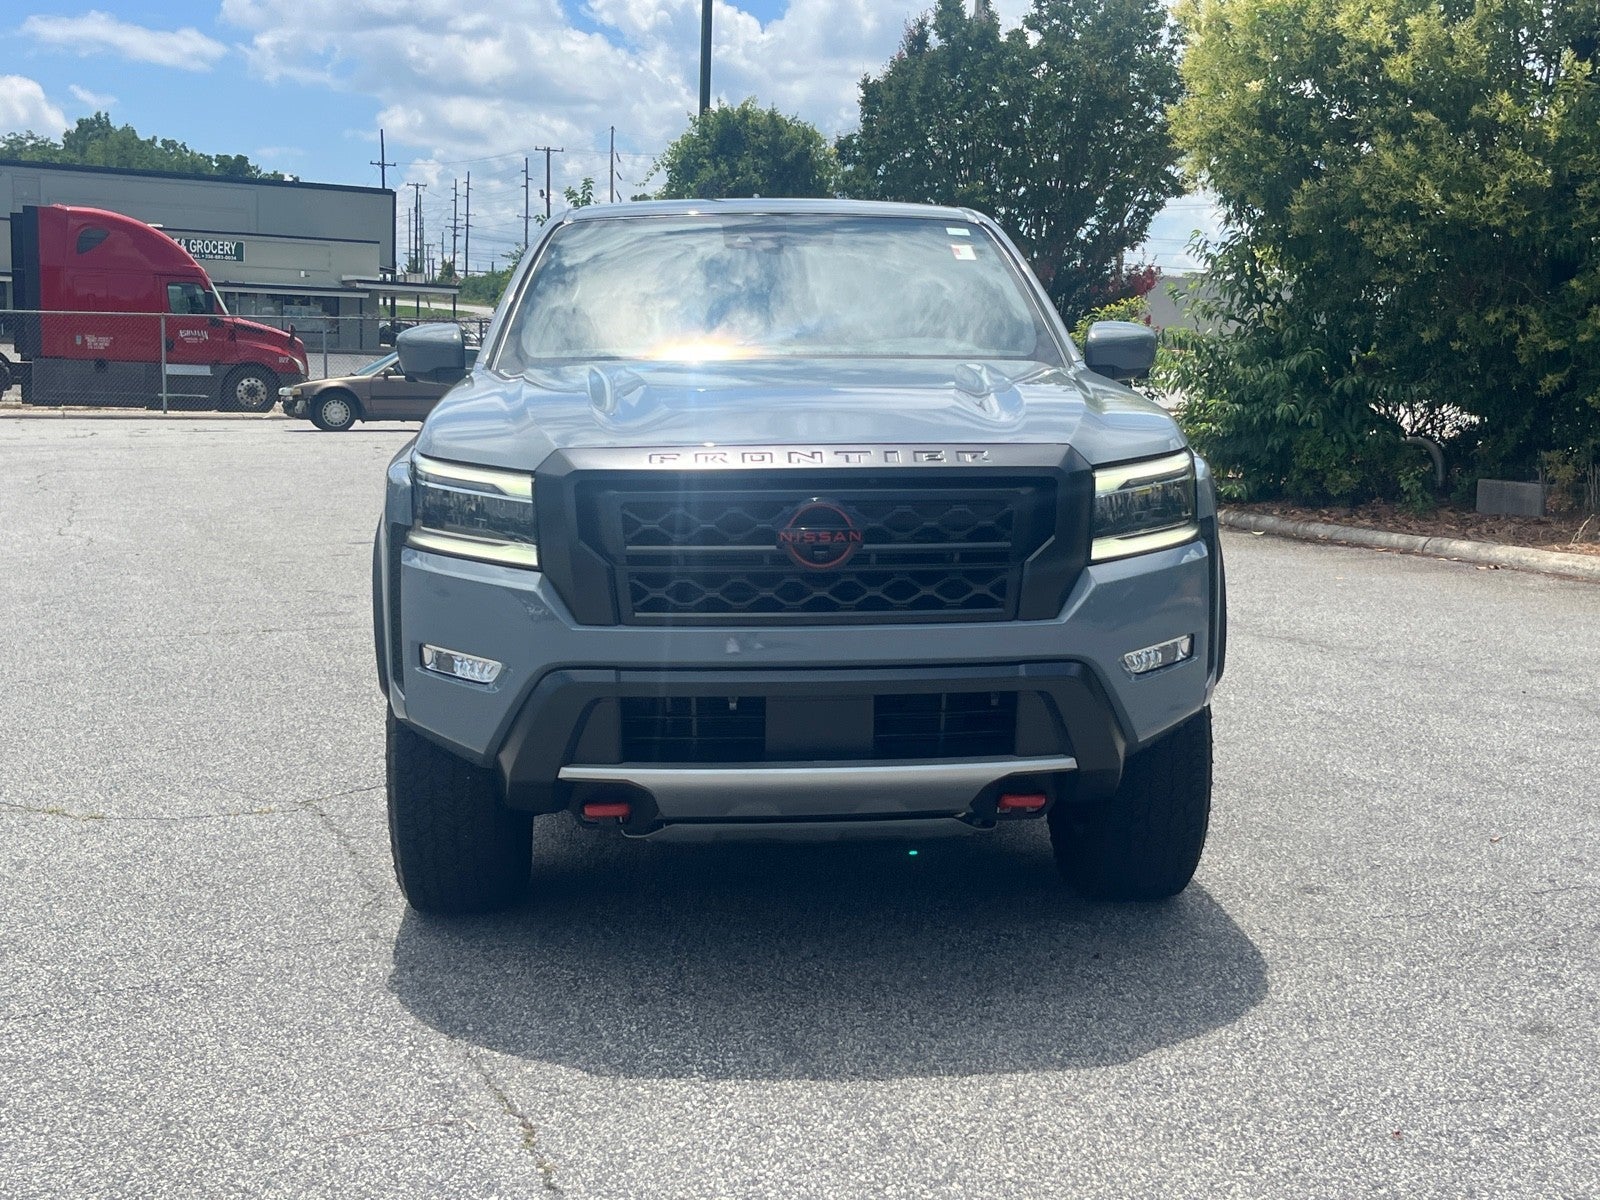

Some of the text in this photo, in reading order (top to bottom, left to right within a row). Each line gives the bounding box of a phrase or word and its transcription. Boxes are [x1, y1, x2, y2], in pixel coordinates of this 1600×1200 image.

[189, 239, 237, 254] GROCERY
[648, 450, 992, 464] FRONTIER
[779, 531, 862, 543] NISSAN
